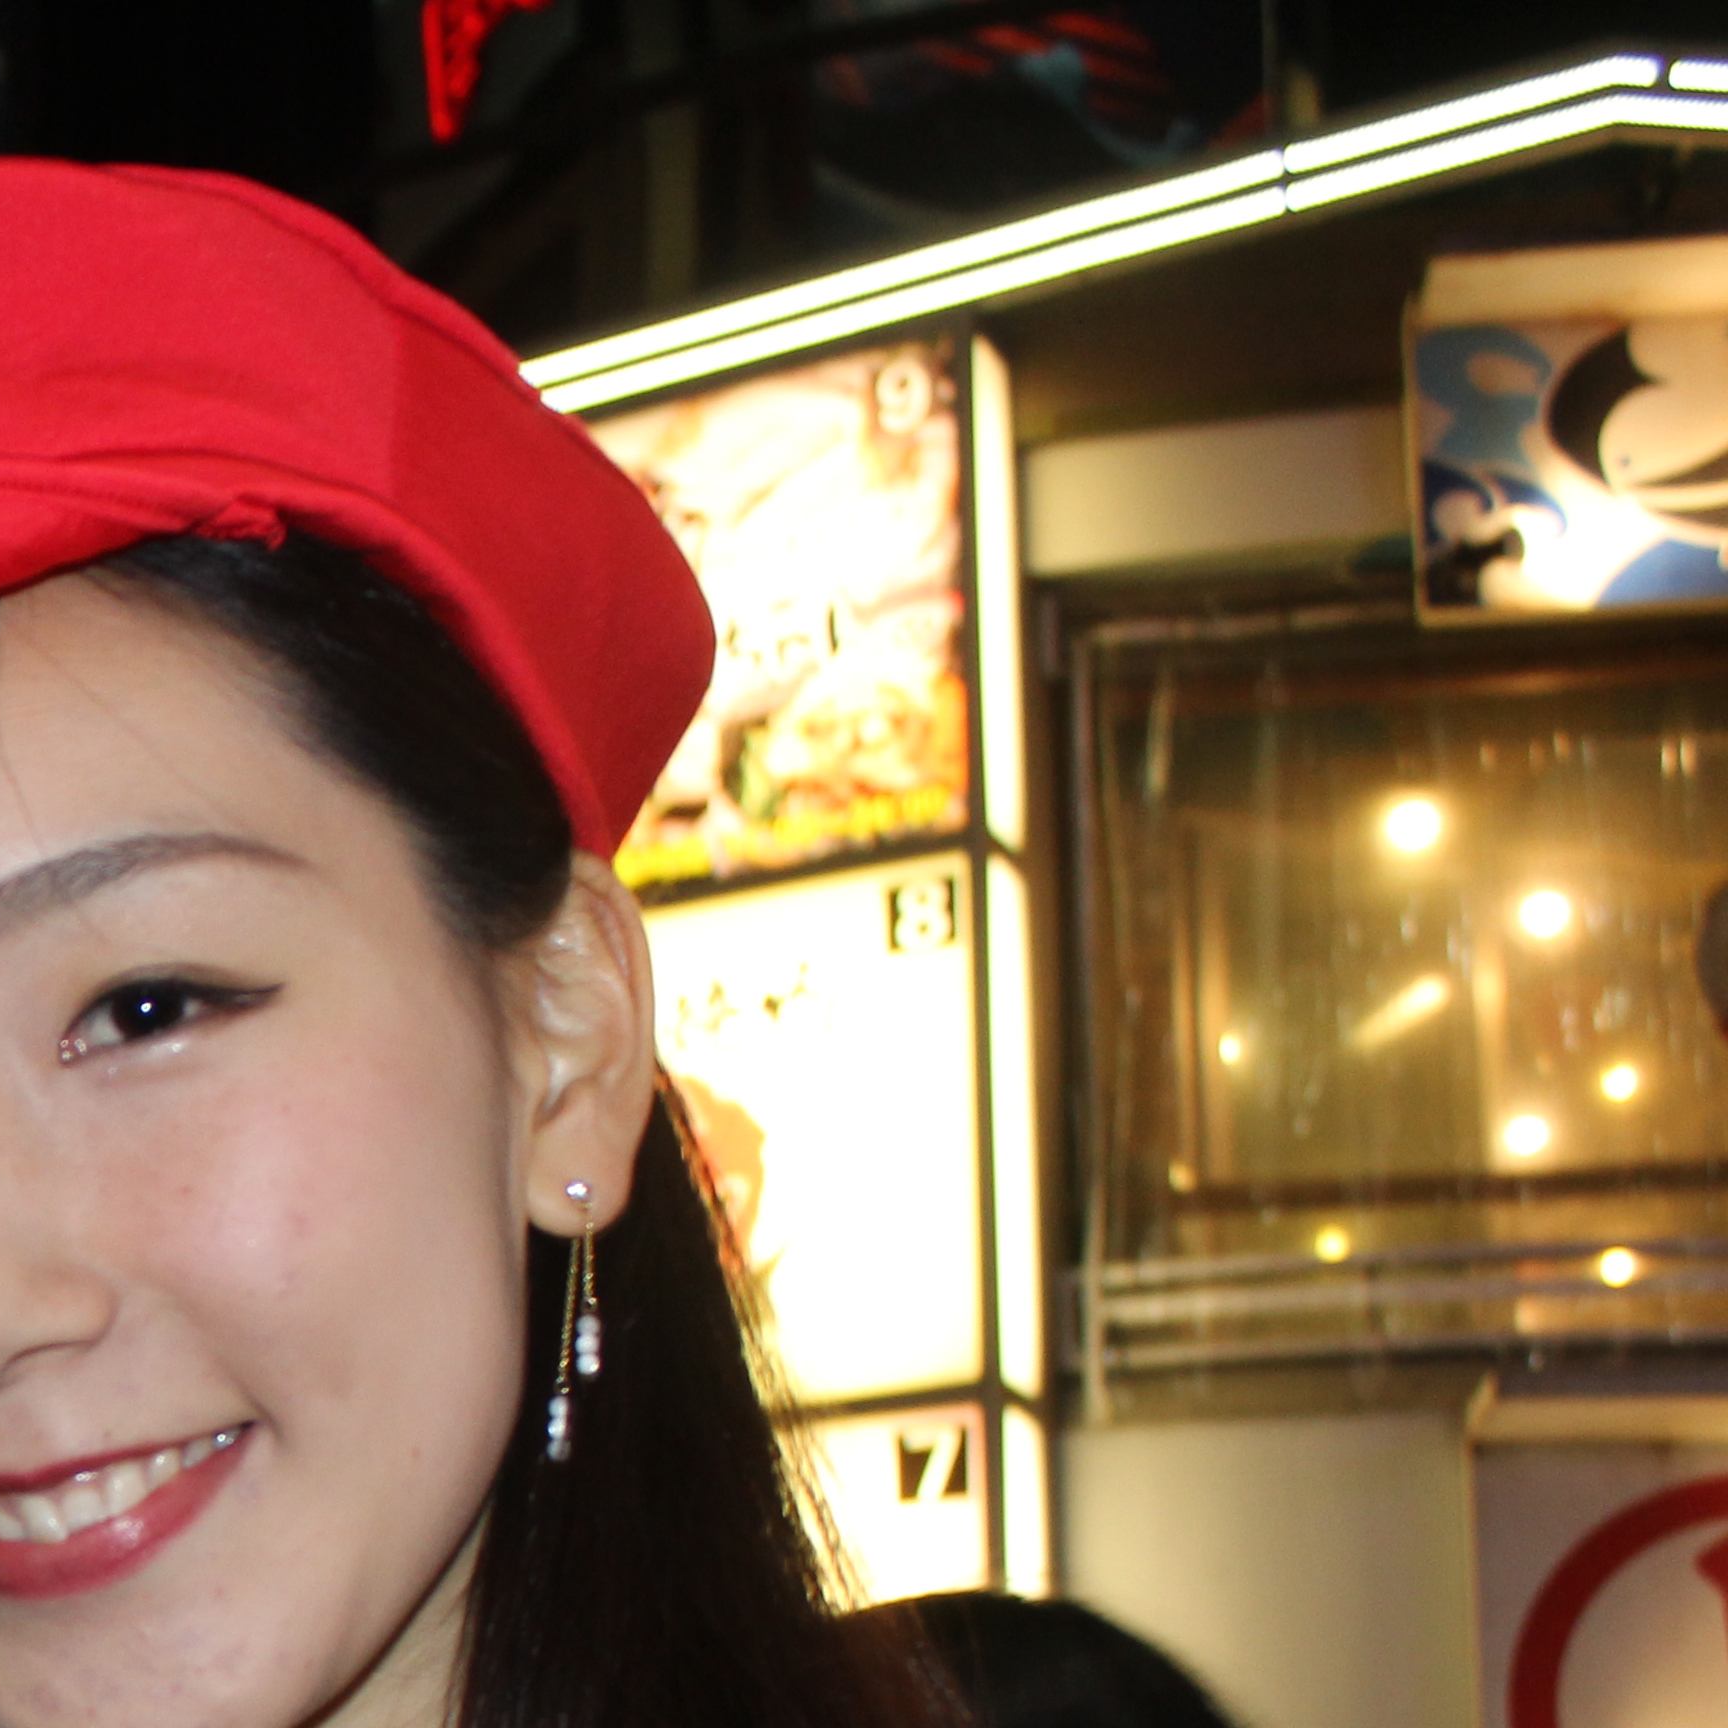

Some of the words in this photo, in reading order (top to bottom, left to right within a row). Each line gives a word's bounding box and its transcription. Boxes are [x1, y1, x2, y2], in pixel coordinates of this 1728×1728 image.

[875, 355, 932, 434] 9
[895, 878, 952, 950] 8
[902, 1426, 964, 1500] 7
